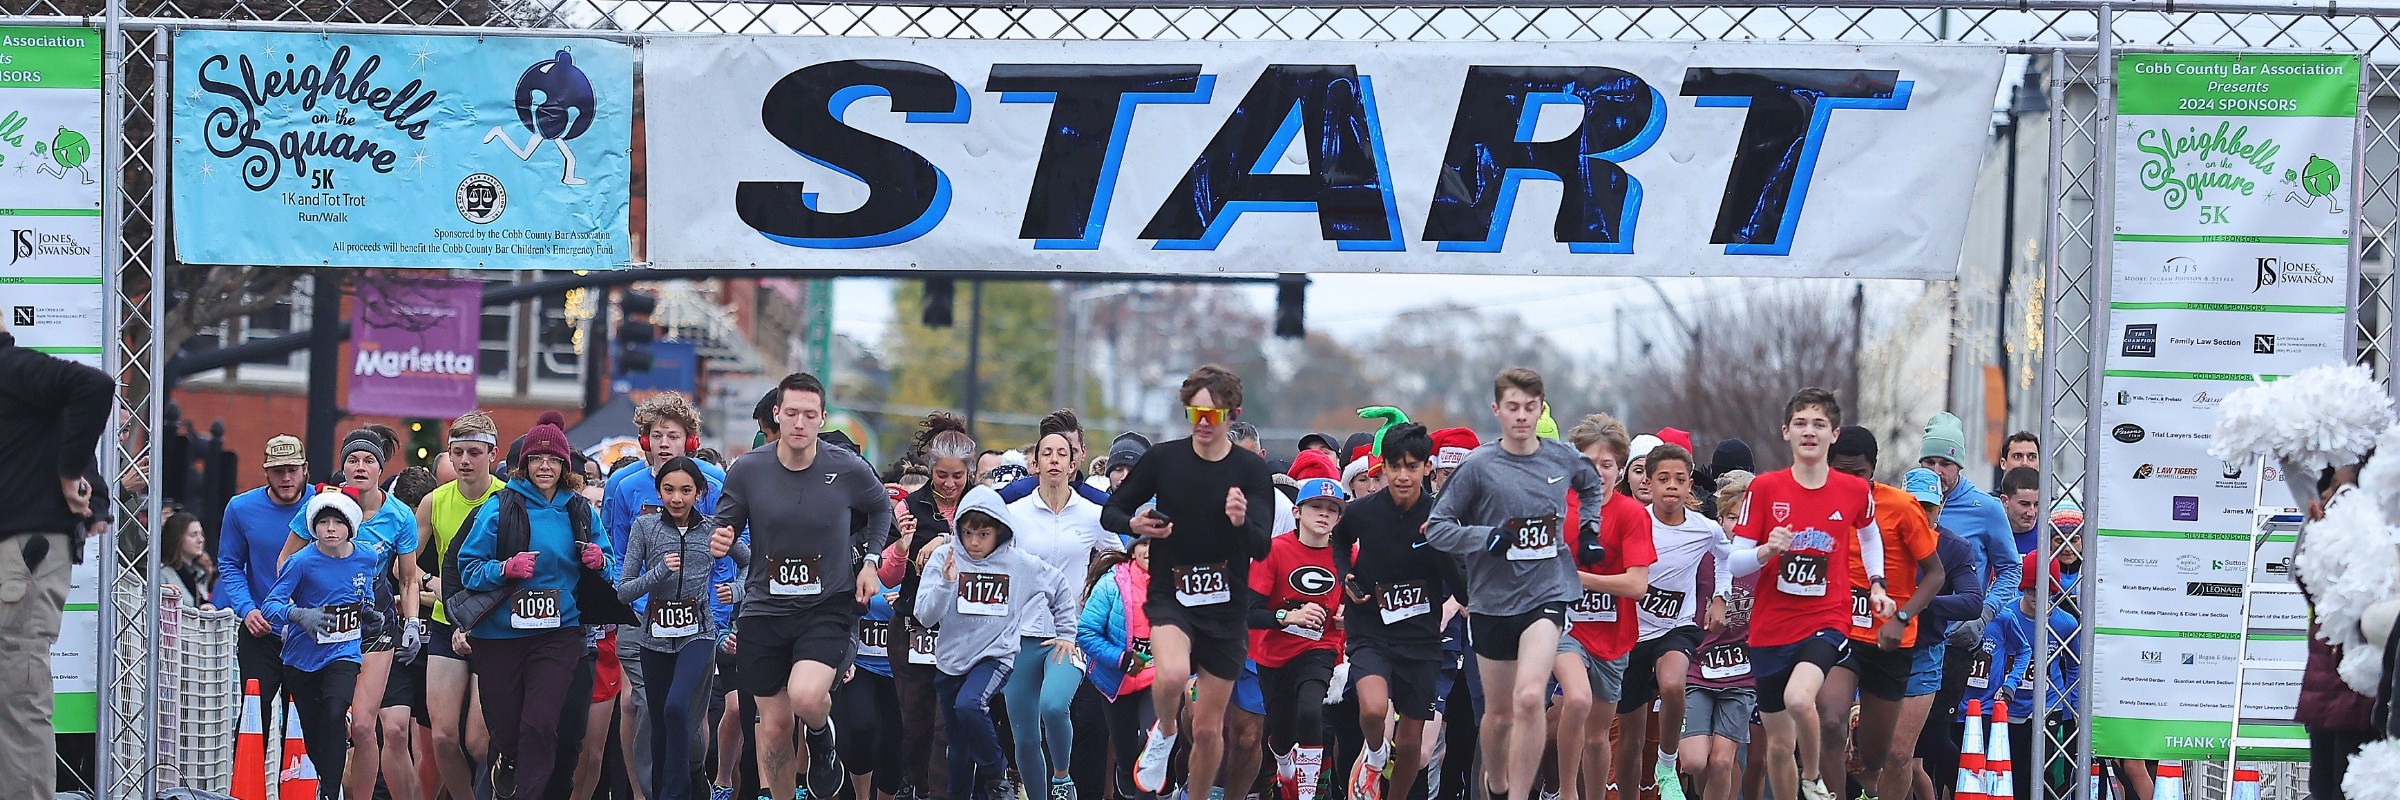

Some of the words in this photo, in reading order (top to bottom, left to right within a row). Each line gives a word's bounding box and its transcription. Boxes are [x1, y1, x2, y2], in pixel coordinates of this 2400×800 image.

[3, 35, 86, 47] Association
[2135, 63, 2172, 75] Cobb
[2175, 63, 2229, 78] County
[2232, 64, 2257, 75] Bar
[2259, 63, 2344, 76] Association
[2207, 81, 2270, 93] Presents
[199, 45, 437, 158] Sleighbells
[2178, 98, 2215, 110] 2024
[2218, 98, 2298, 111] SPONSORS
[311, 113, 330, 125] on
[335, 107, 356, 126] the
[239, 119, 397, 191] Square
[735, 58, 1912, 253] START
[2136, 120, 2281, 190] Sleighbells
[2205, 161, 2217, 169] on
[2219, 157, 2233, 169] the
[311, 168, 334, 190] 5K
[2163, 167, 2255, 210] Square
[282, 192, 297, 206] 1K
[298, 192, 320, 206] and
[322, 192, 341, 206] Tot
[343, 193, 366, 207] Trot
[298, 211, 348, 223] Run/Walk
[2199, 205, 2231, 225] 5K
[39, 233, 71, 244] JONES
[434, 228, 475, 240] Sponsored
[476, 229, 486, 240] by
[488, 229, 500, 239] the
[502, 229, 523, 239] Cobb
[525, 230, 552, 242] County
[554, 230, 569, 240] Bar
[38, 245, 91, 256] SWANSON
[332, 241, 345, 251] All
[347, 242, 381, 254] proceeds
[383, 242, 397, 252] will
[400, 242, 426, 253] benefit
[428, 243, 440, 253] the
[442, 243, 463, 253] Cobb
[465, 244, 493, 256] County
[495, 244, 508, 254] Bar
[511, 244, 551, 254] Children's
[553, 245, 594, 257] Emergency
[596, 245, 613, 255] Fund
[2282, 262, 2316, 273] JONES
[2281, 274, 2334, 284] SWANSON
[2170, 337, 2195, 346] Family
[2213, 338, 2241, 346] Section
[354, 346, 475, 378] Marietta
[1519, 526, 1549, 547] 836
[2184, 532, 2209, 540] SILVER
[780, 565, 809, 583] 848
[1787, 562, 1817, 584] 964
[966, 581, 1003, 602] 1174
[1181, 572, 1223, 594] 1323
[2206, 585, 2243, 594] LEONARD
[517, 597, 554, 617] 1098
[1383, 587, 1422, 610] 1437
[1642, 593, 1678, 618] 1240
[657, 606, 694, 626] 1035
[2211, 632, 2251, 640] SPONSOS
[1706, 647, 1744, 668] 1413
[2164, 736, 2215, 749] THANK
